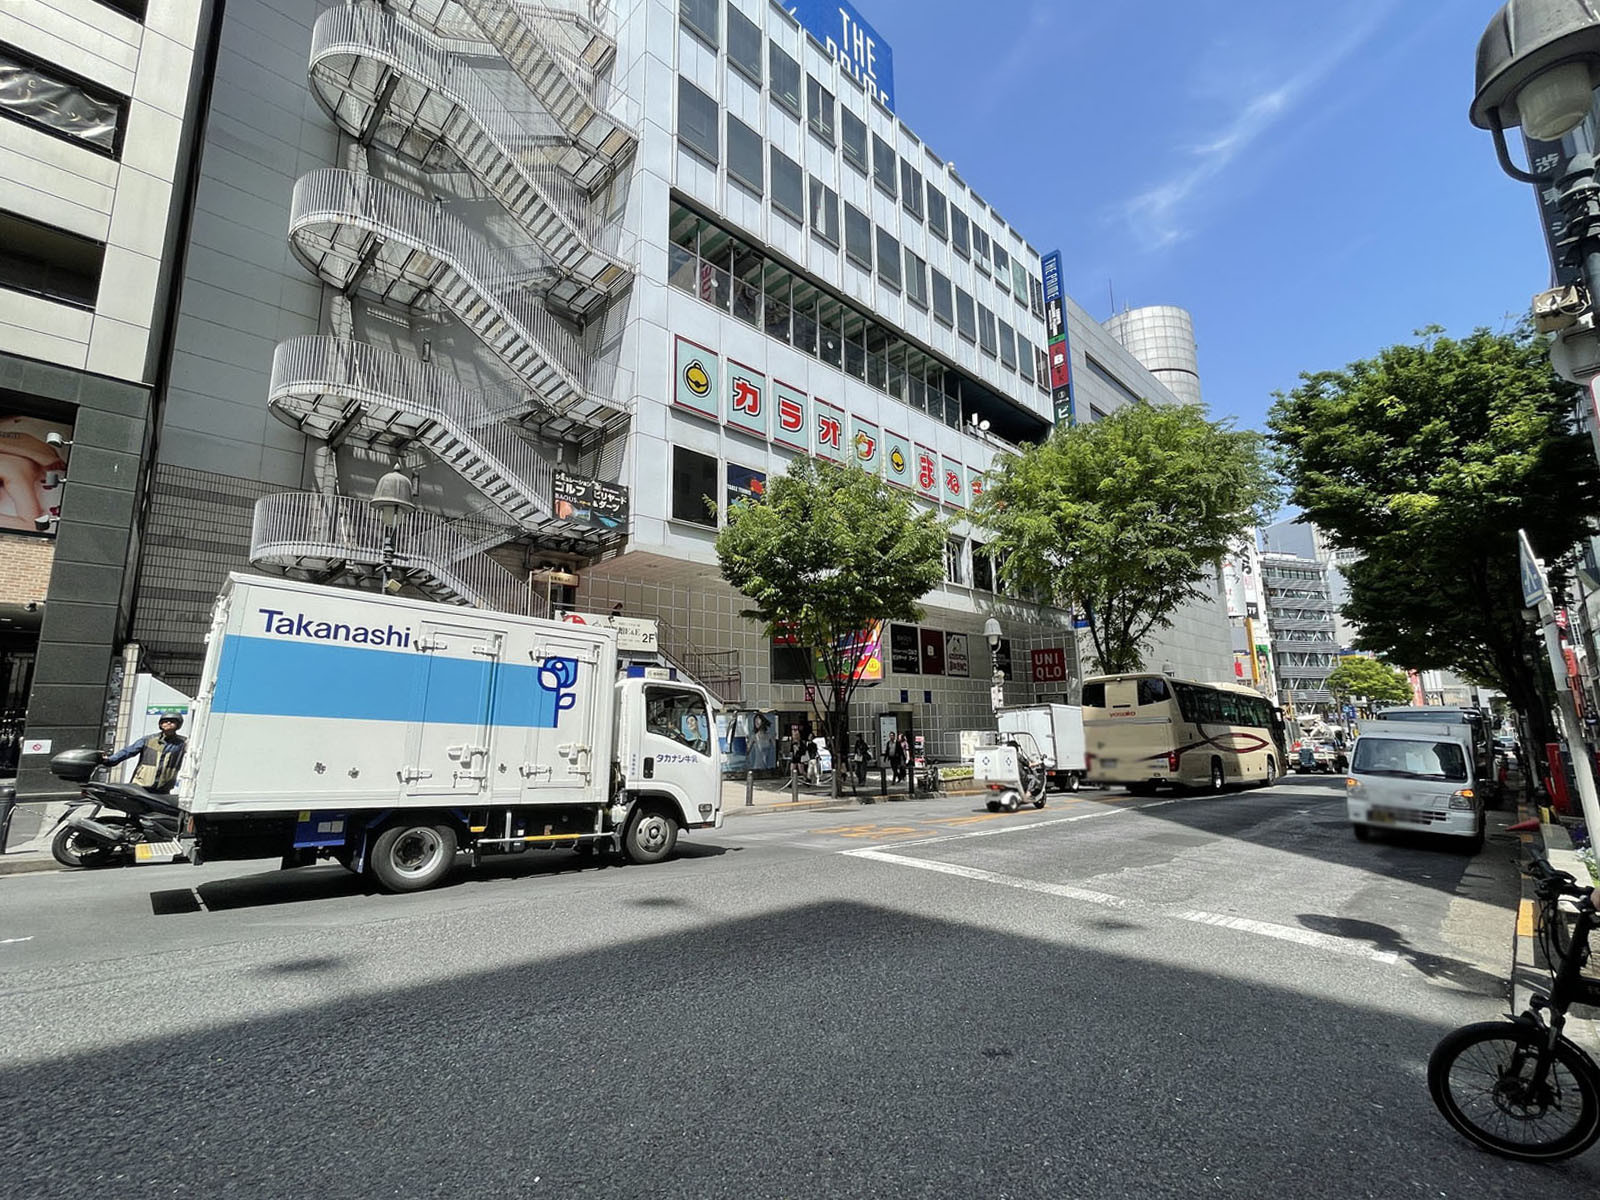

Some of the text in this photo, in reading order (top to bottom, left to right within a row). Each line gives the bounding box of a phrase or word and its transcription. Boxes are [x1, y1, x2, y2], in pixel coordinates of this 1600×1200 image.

[838, 7, 877, 79] THE
[733, 376, 877, 461] カラオケ
[554, 481, 586, 497] ゴルフ
[593, 490, 628, 505] ビリヤード
[258, 608, 412, 648] Takanashi
[641, 633, 655, 644] 2F
[1034, 652, 1059, 666] UNI
[1035, 669, 1063, 681] QLO
[655, 753, 698, 764] タカナシ牛乳
